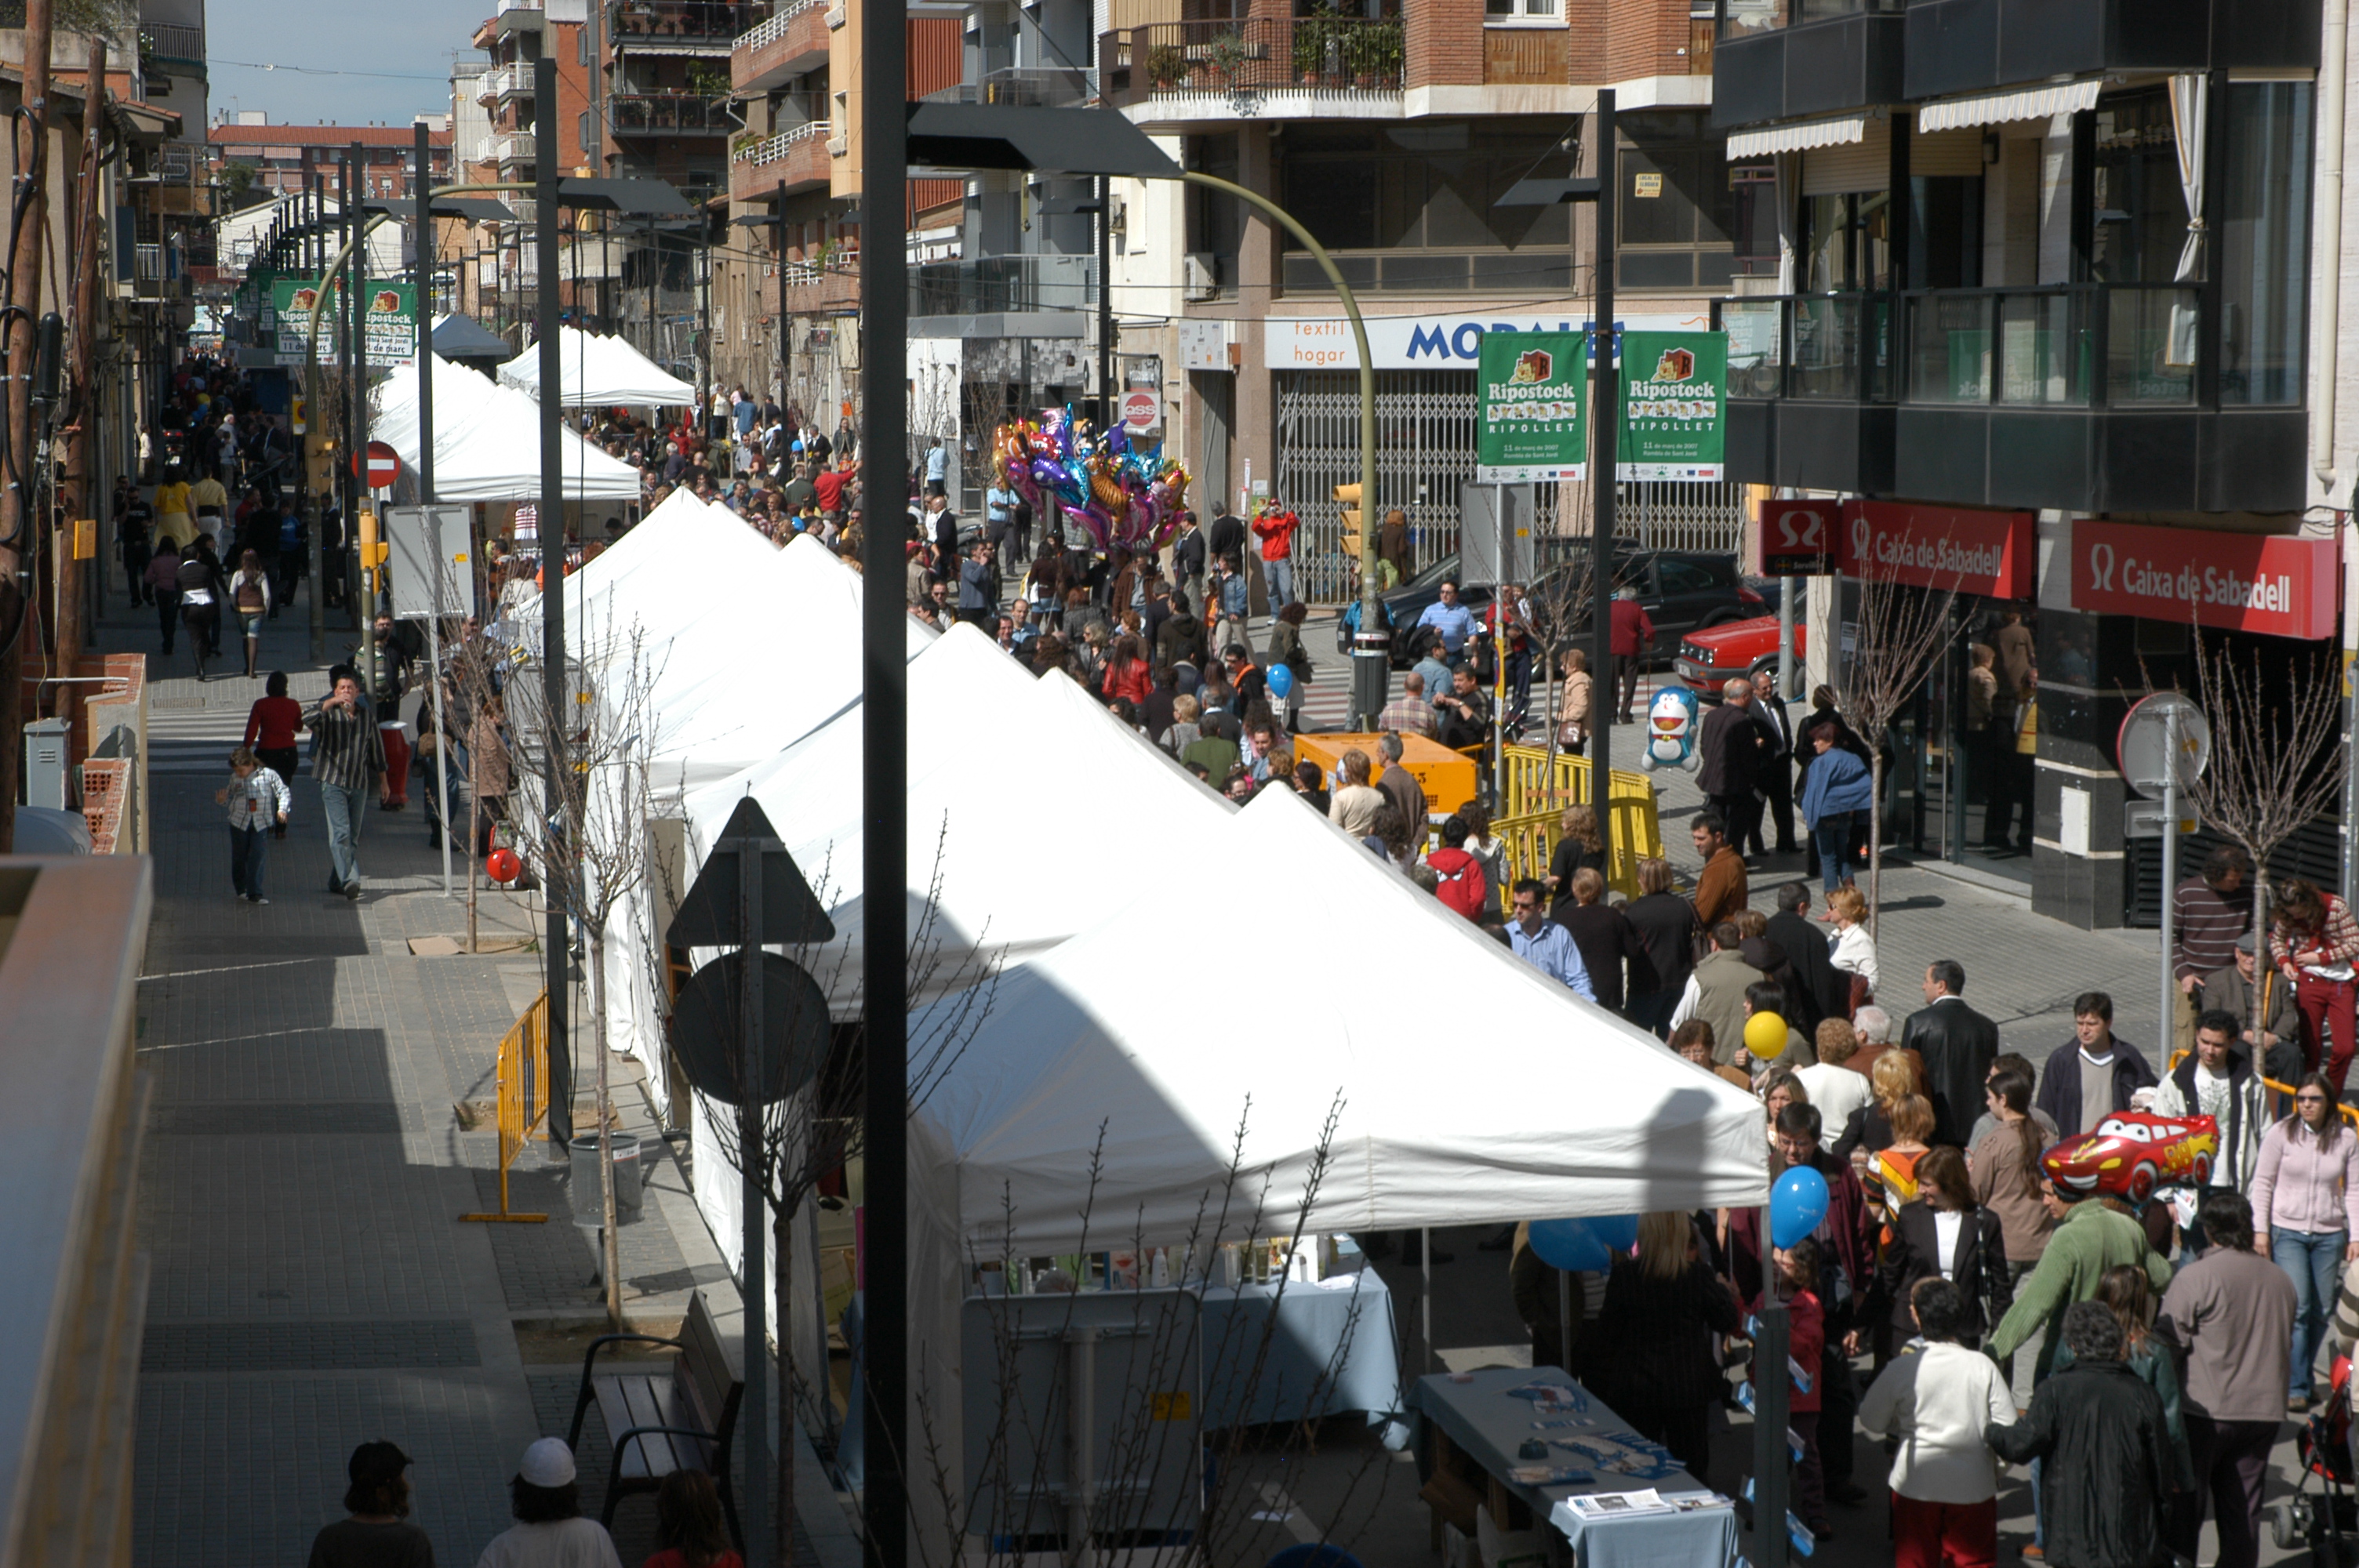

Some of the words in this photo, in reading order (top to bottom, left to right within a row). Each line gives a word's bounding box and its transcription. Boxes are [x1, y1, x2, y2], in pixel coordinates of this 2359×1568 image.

[365, 313, 412, 324] ipostock
[1294, 320, 1345, 336] textil
[295, 342, 305, 350] de
[373, 343, 383, 352] de
[1294, 345, 1345, 366] hogar
[1488, 382, 1576, 403] Ripostock
[1630, 380, 1716, 401] Ripostock
[1125, 405, 1156, 416] QSS
[1488, 423, 1575, 434] RIPOLLET
[1629, 421, 1714, 431] RIPOLLET
[1643, 441, 1652, 449] 11
[1876, 531, 1914, 566] Caixa
[1917, 538, 1935, 568] de
[1937, 538, 2001, 577] Sabadell
[2123, 557, 2172, 598] Caixa
[2176, 565, 2201, 601] de
[2204, 566, 2290, 613] Sabadell
